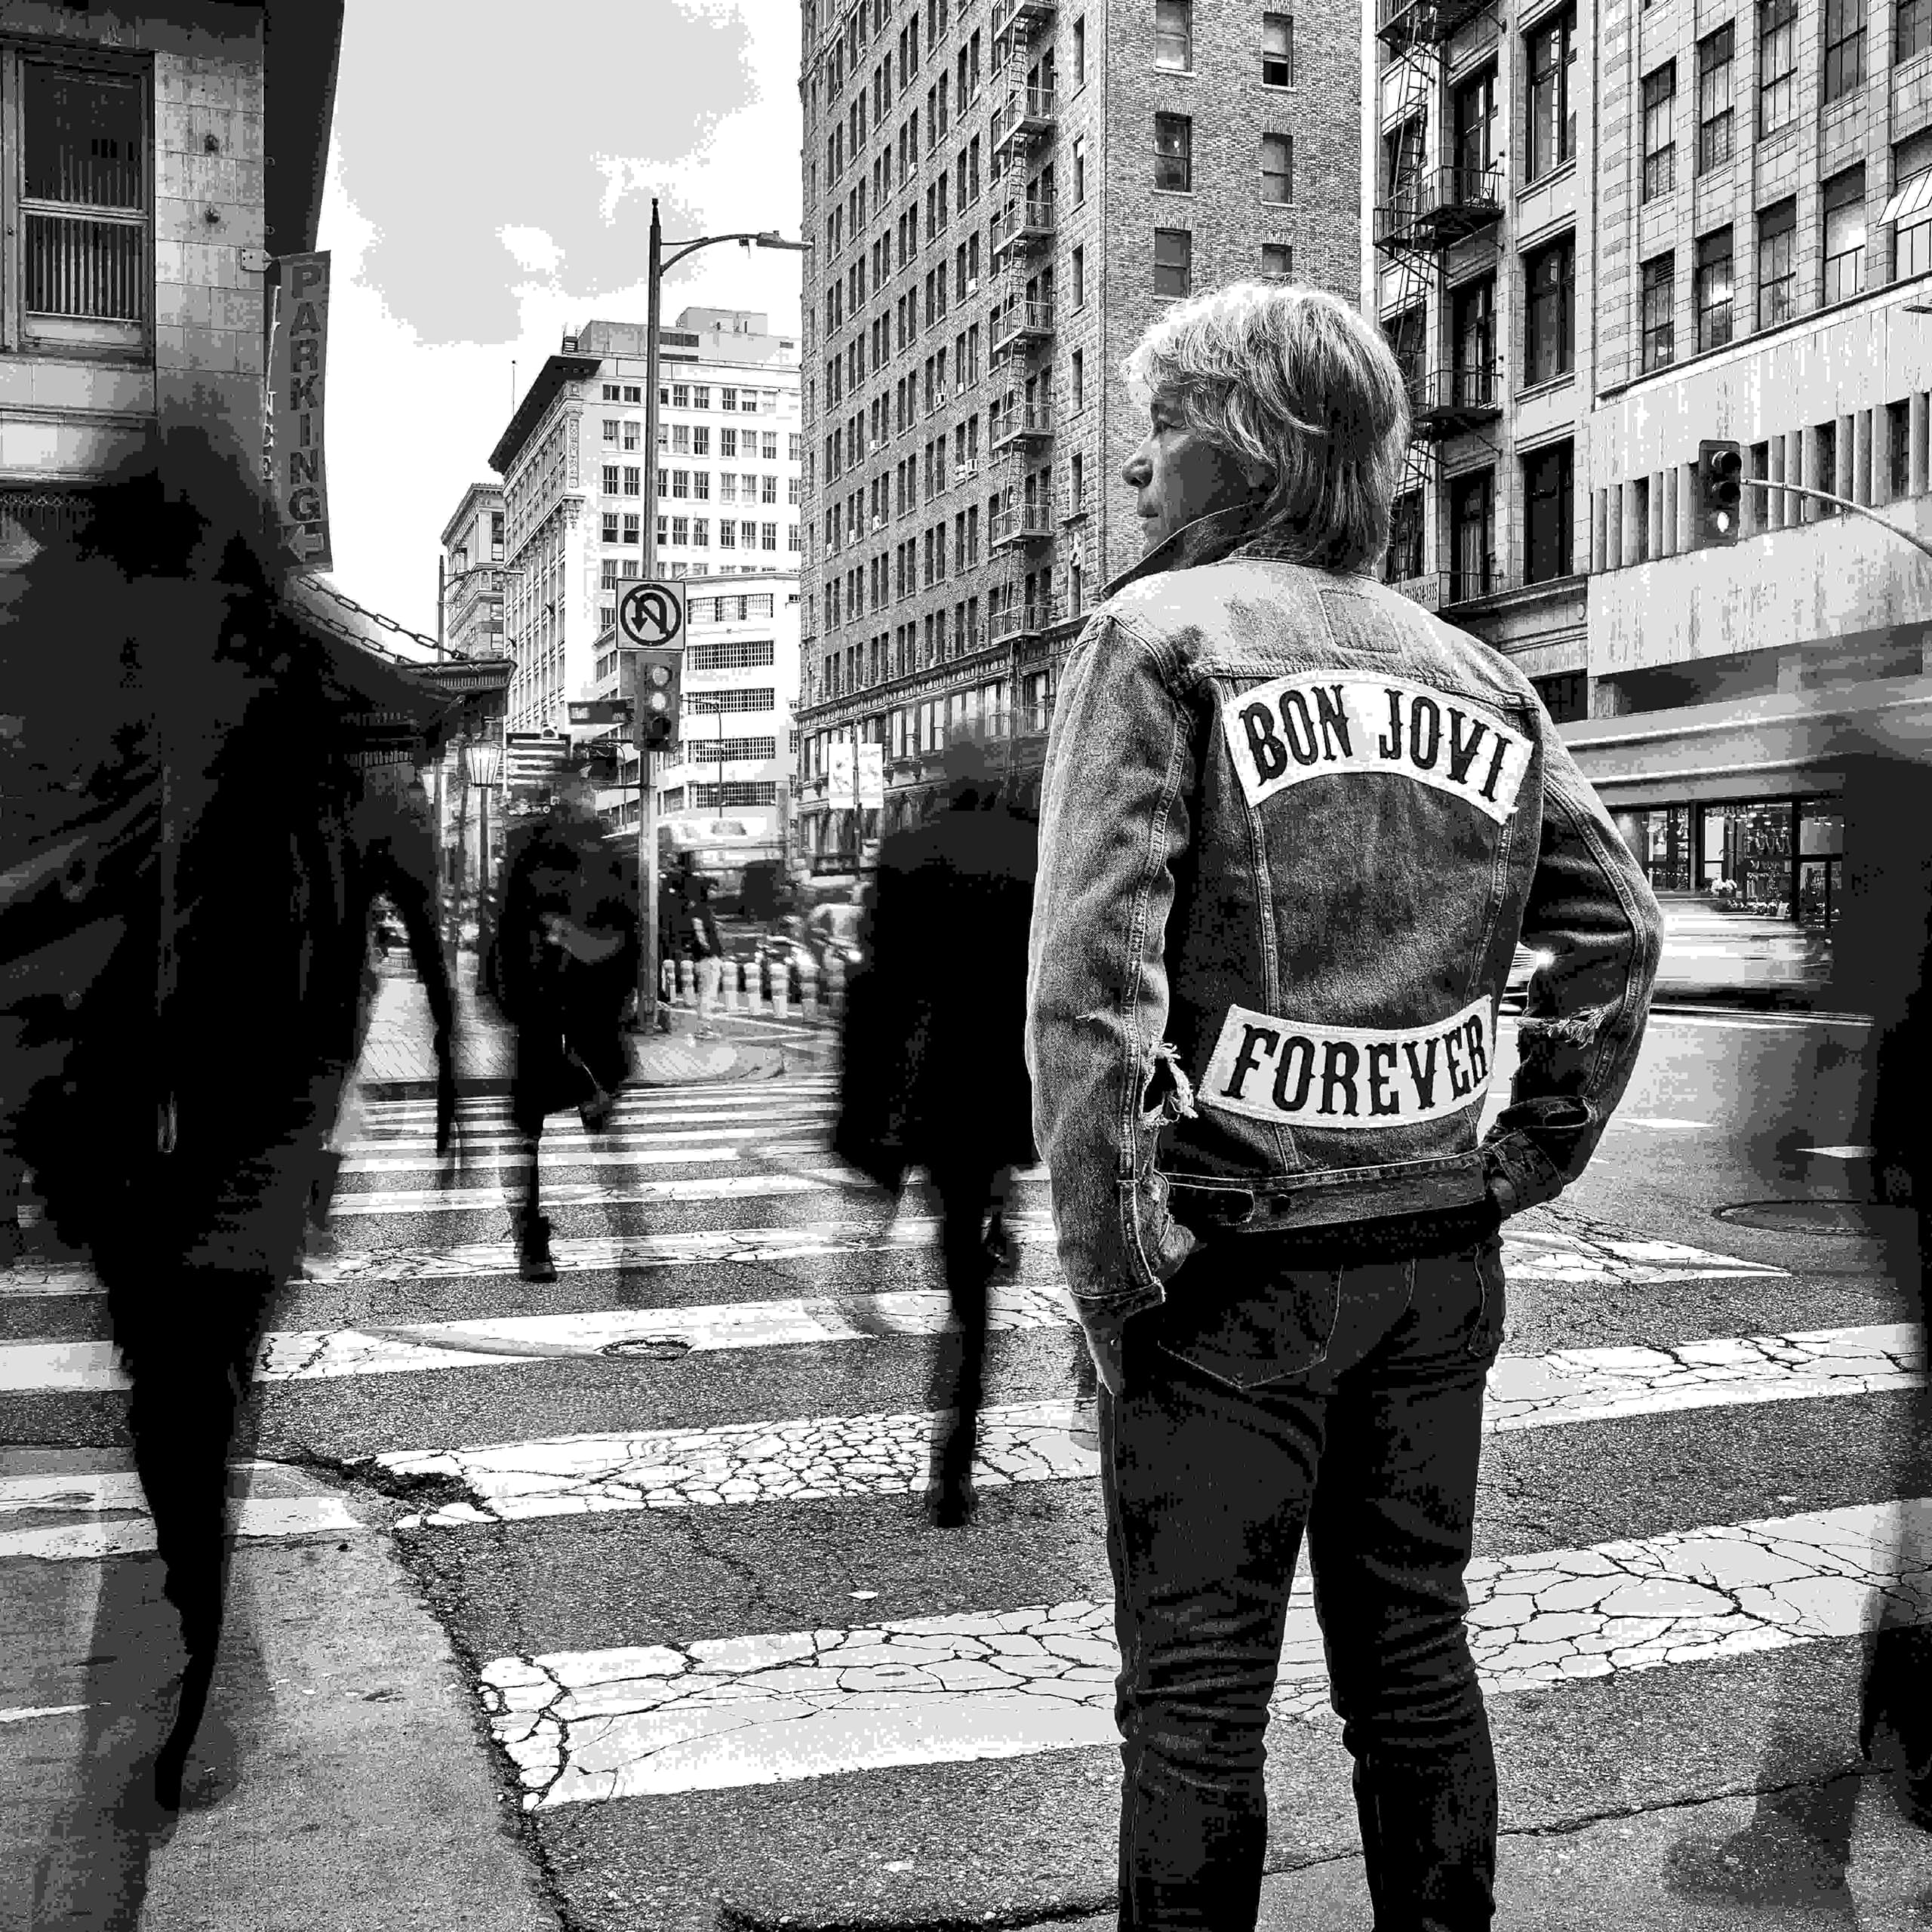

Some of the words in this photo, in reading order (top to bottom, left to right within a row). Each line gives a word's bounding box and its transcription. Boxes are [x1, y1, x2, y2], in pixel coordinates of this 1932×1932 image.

[288, 265, 321, 521] PARKING
[1239, 684, 1353, 786] BON
[1379, 688, 1512, 802] JOVI
[1220, 1014, 1488, 1117] FOREVER
